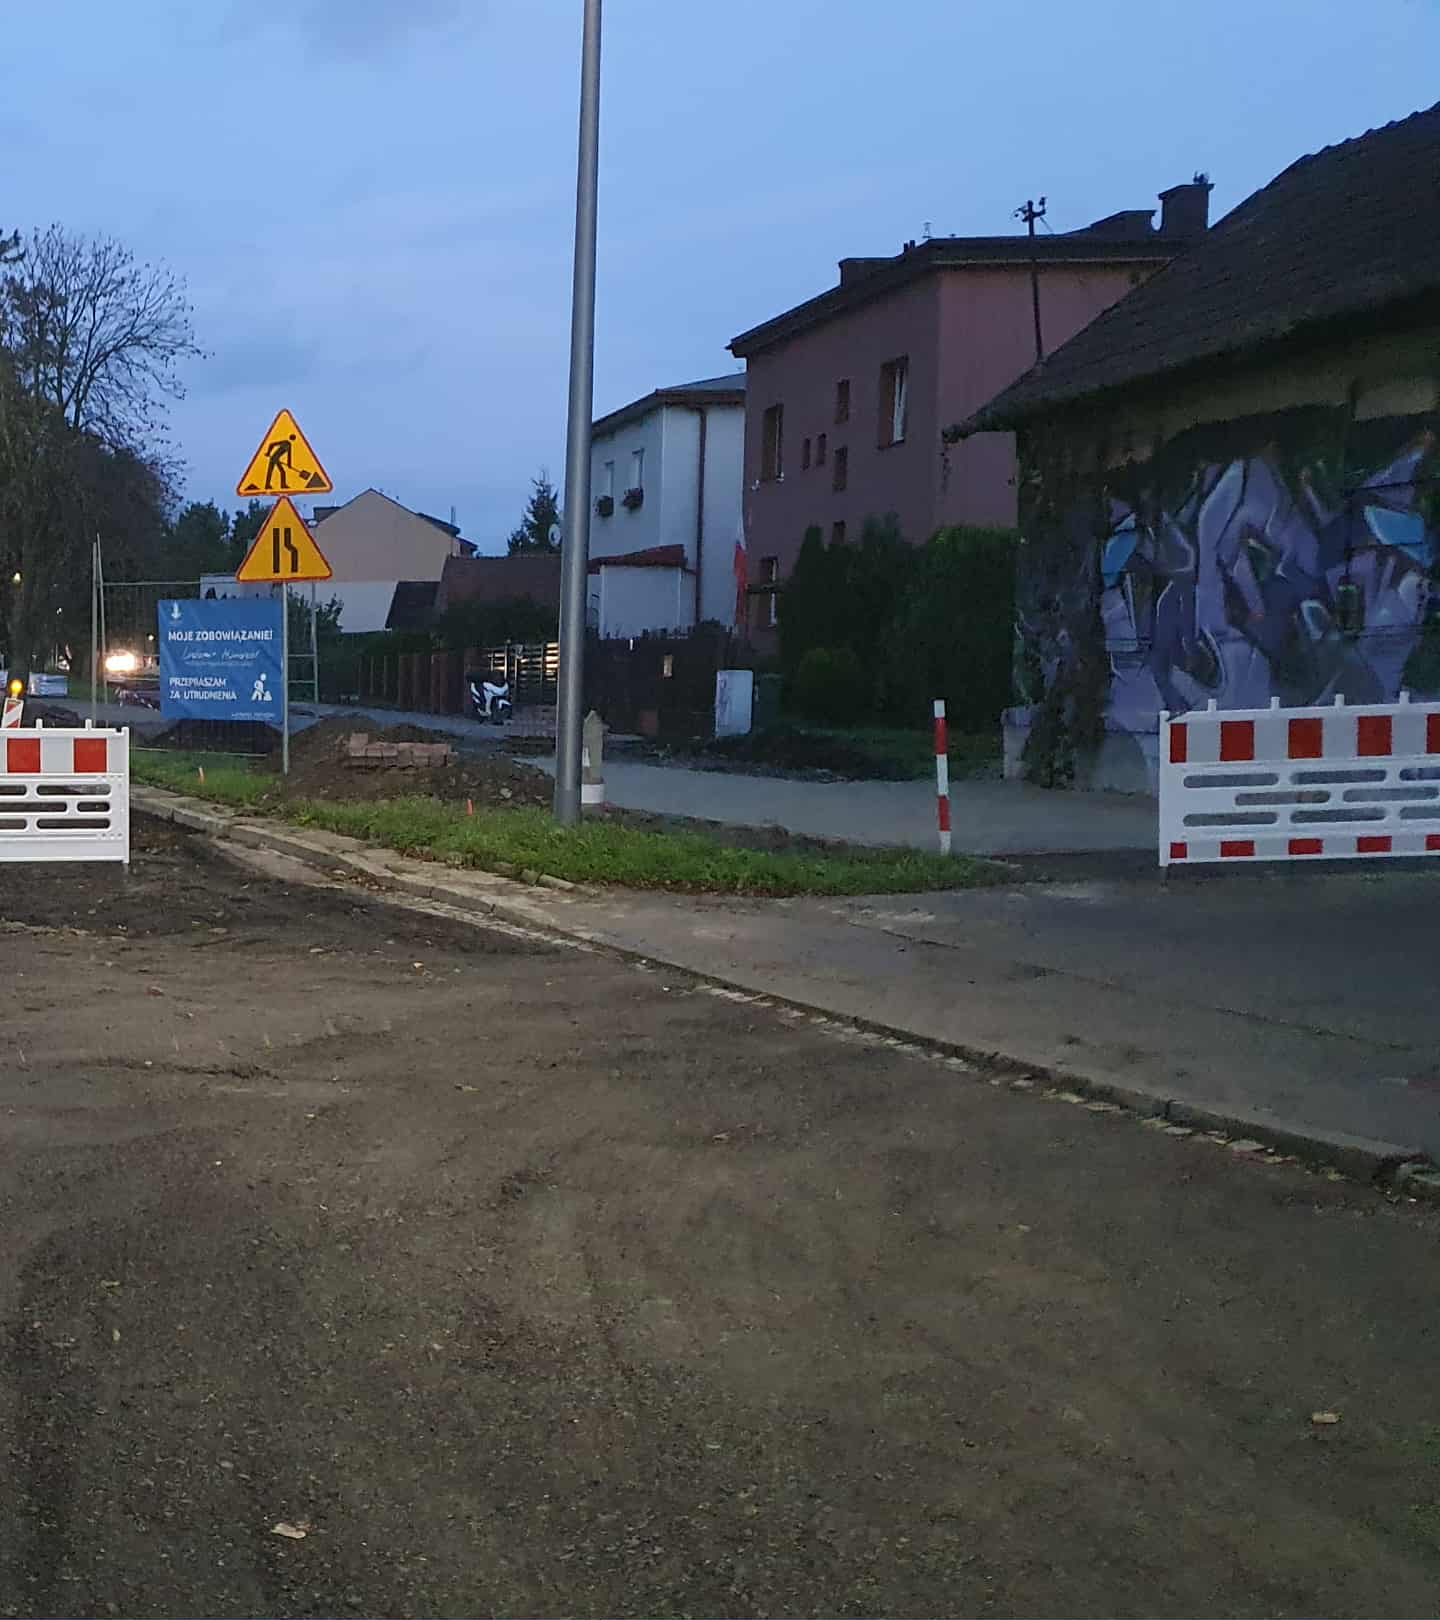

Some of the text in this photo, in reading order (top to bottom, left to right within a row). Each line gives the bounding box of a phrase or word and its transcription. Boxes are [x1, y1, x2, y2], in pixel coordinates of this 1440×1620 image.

[168, 630, 193, 641] MOJE
[169, 677, 227, 687] PRZEPRASZAM
[169, 690, 237, 700] ZA UTRUDNIENIA
